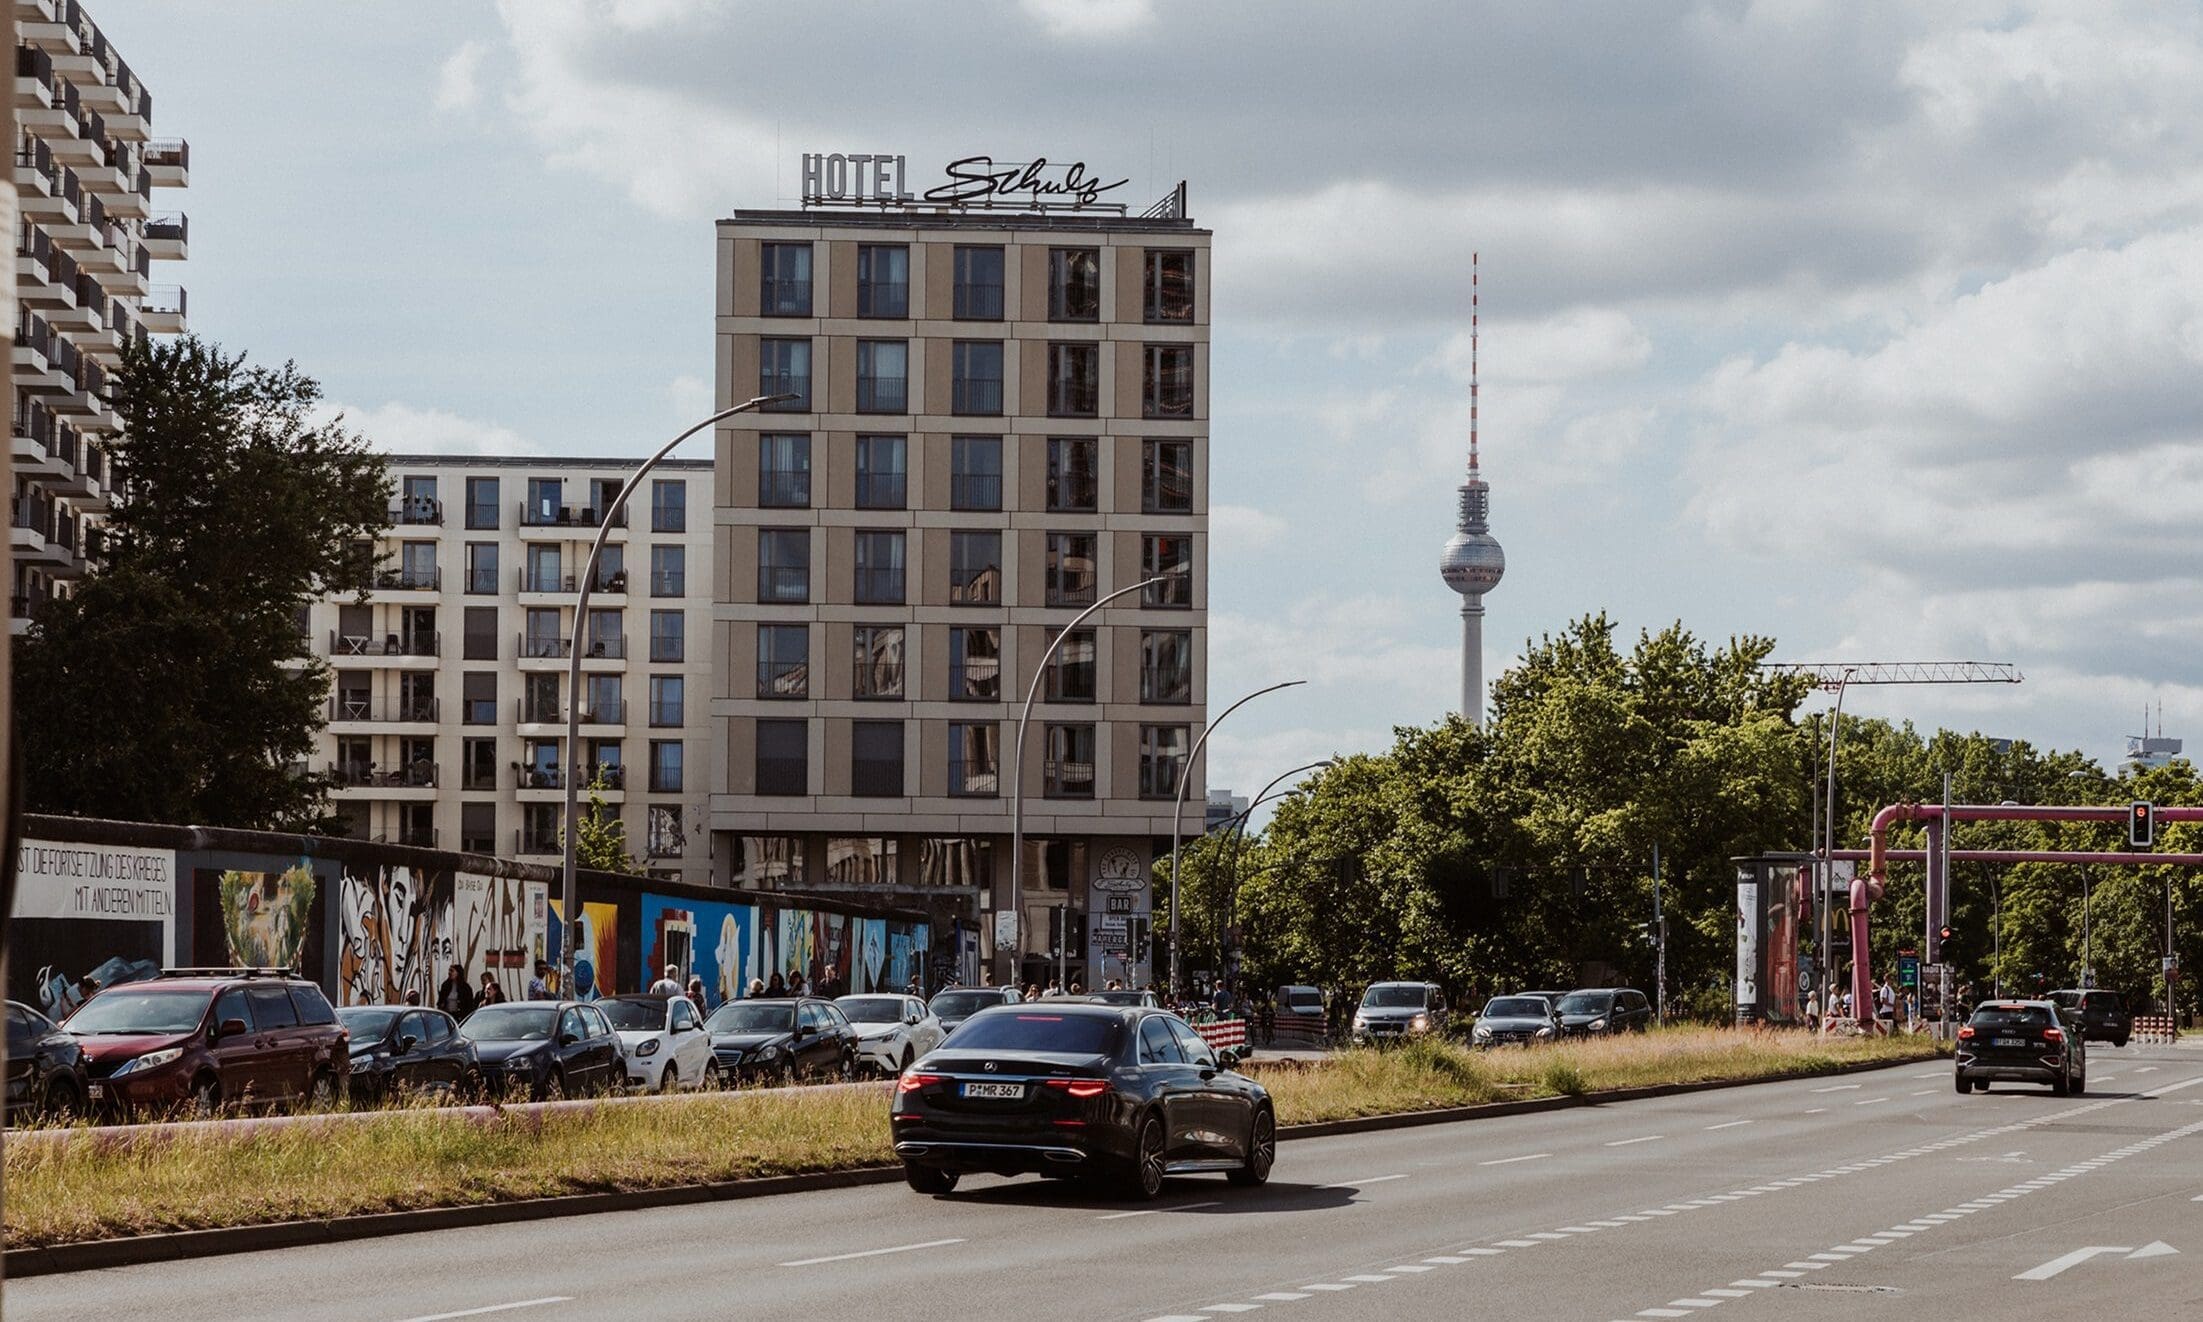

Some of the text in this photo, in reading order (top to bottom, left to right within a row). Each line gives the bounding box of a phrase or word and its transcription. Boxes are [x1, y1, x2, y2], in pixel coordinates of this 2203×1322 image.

[802, 153, 1129, 204] HOTEL Schulz
[49, 849, 113, 879] FORTSETZUNG
[115, 854, 132, 880] DES
[91, 887, 134, 914] ANDEREN
[1110, 898, 1130, 911] BAR
[969, 1085, 976, 1096] P
[999, 1086, 1020, 1097] 367
